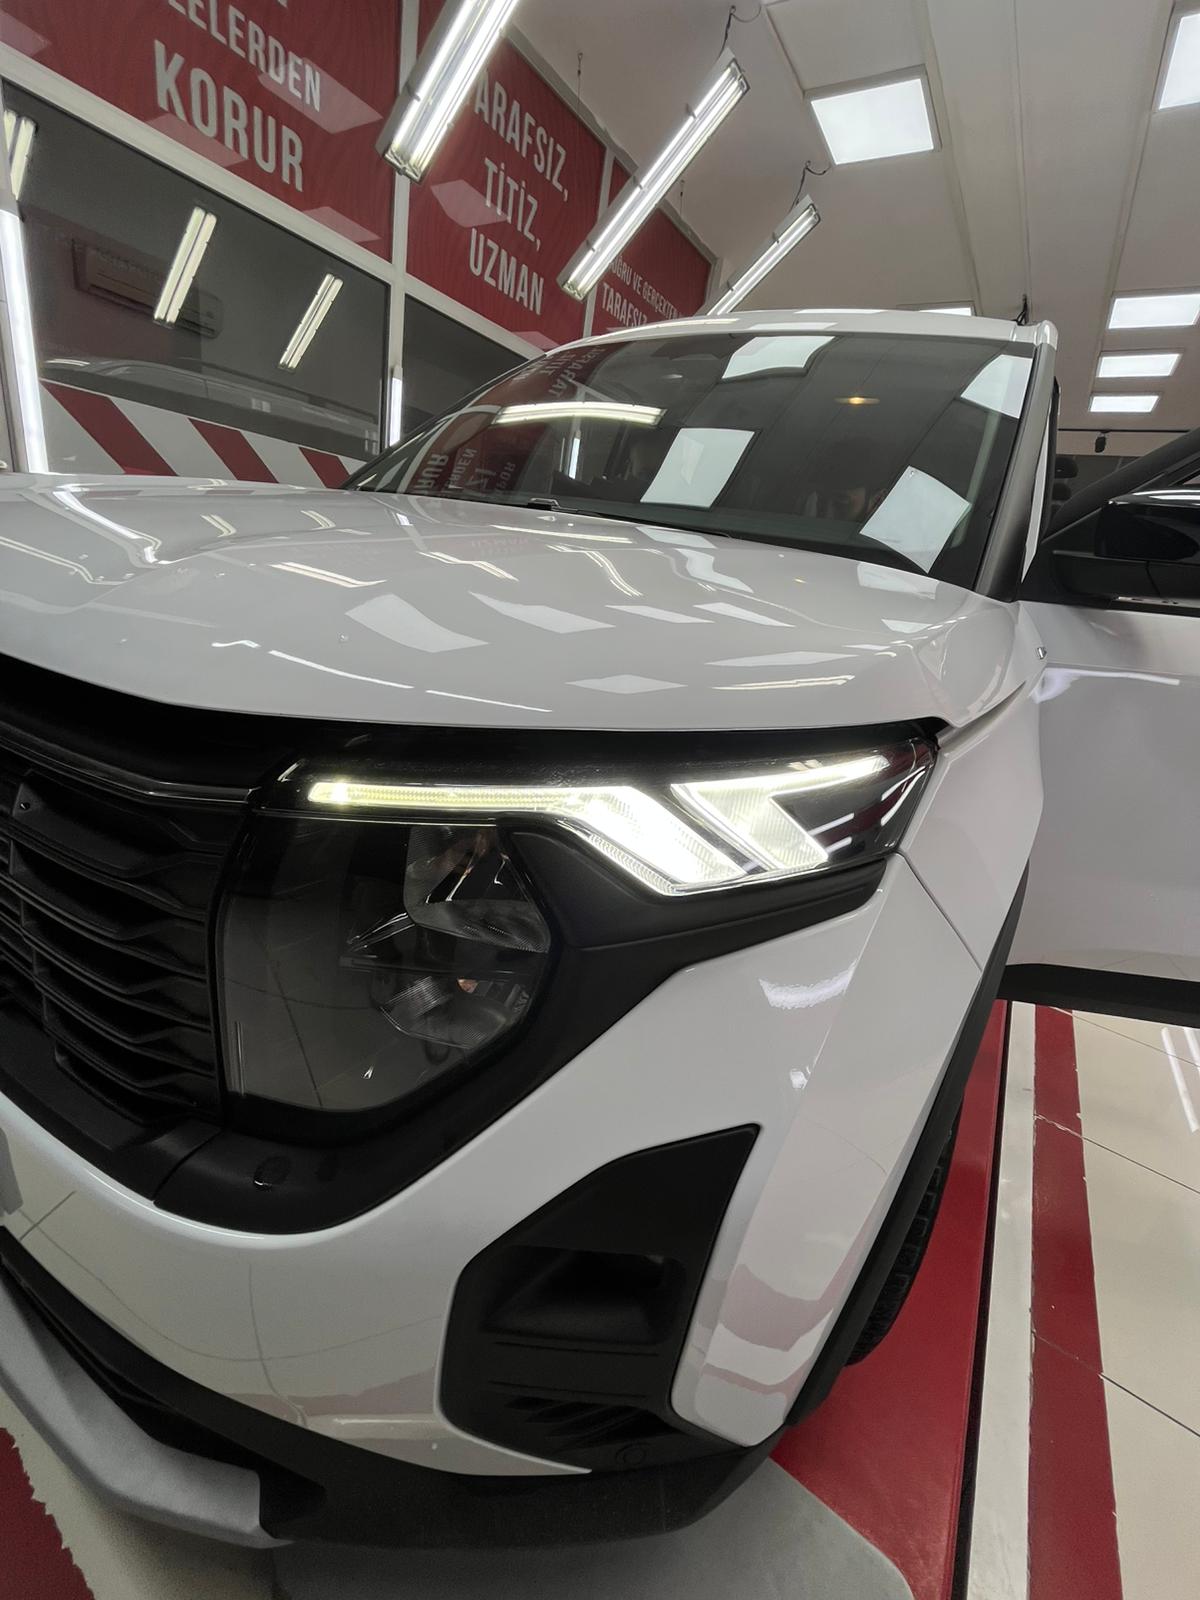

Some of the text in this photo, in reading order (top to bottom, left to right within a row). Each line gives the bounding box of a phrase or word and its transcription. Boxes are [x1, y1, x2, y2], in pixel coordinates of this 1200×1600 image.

[154, 39, 303, 192] KORUR
[475, 70, 568, 202] ARAFSIZ,
[484, 157, 541, 251] TİTİZ,
[469, 227, 544, 315] UZMAN
[632, 271, 643, 295] VE
